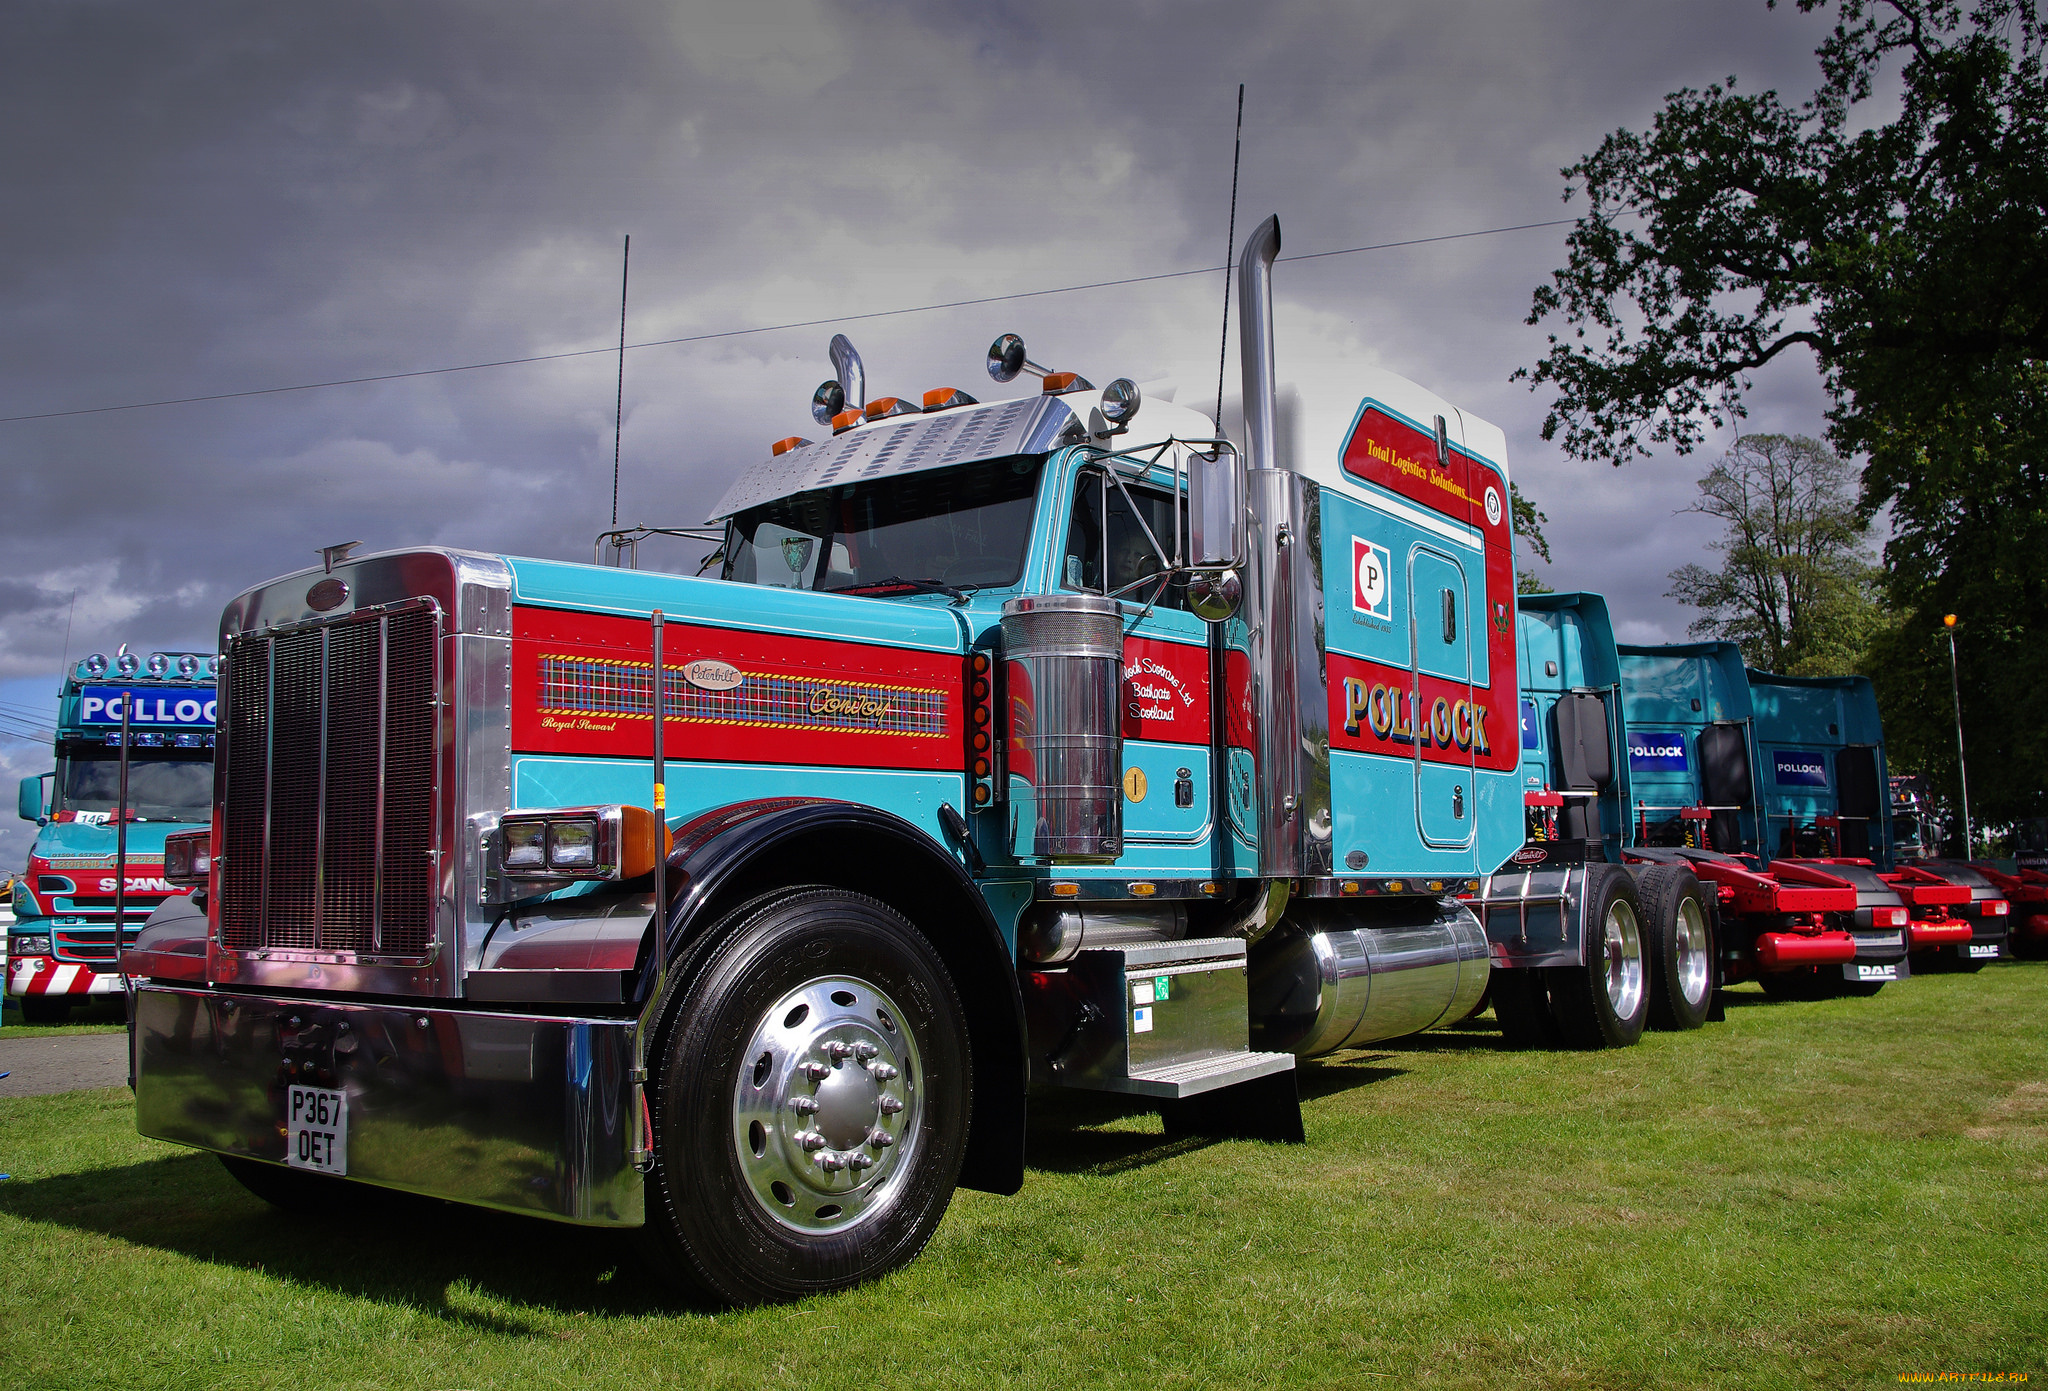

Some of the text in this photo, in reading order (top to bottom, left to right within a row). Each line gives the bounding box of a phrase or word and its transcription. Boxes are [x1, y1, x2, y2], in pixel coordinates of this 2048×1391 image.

[1367, 438, 1390, 463] Total
[1391, 449, 1428, 480] Logistics
[1367, 565, 1378, 590] P
[691, 664, 738, 683] Peterbilt
[1142, 658, 1179, 688] Scotrans
[1178, 683, 1195, 707] Ltd
[1132, 682, 1171, 704] Bathgate
[1129, 703, 1175, 721] Scotland
[1342, 676, 1491, 757] POLLOCK
[541, 717, 617, 733] Royal Stewart
[1628, 746, 1684, 757] POLLOCK
[1777, 763, 1823, 774] POLLOCK
[82, 814, 105, 826] 146
[1514, 850, 1545, 861] Peterbilt
[1969, 945, 1999, 954] DAF
[1858, 964, 1897, 975] DAF
[710, 938, 833, 1082] KUMHO
[293, 1090, 341, 1127] P367
